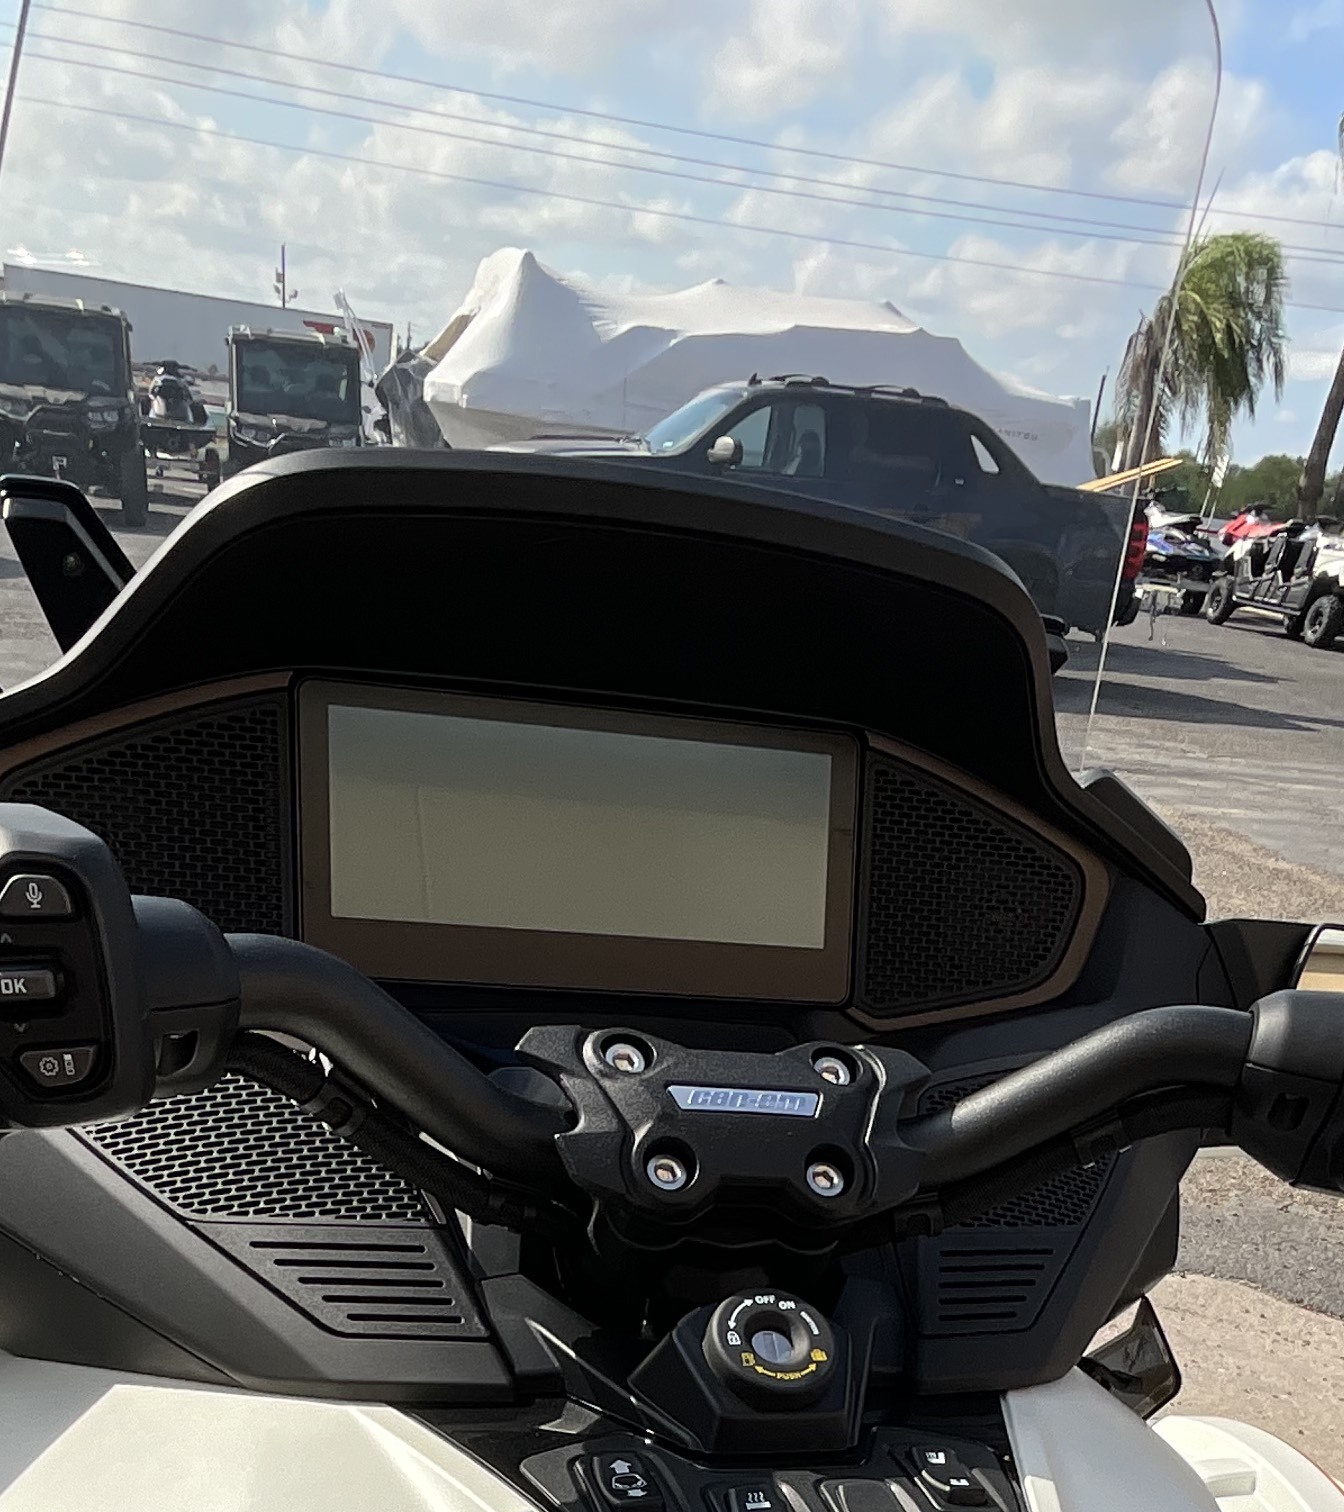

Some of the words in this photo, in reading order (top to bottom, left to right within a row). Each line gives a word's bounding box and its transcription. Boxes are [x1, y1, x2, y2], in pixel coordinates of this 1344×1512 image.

[1, 978, 27, 994] OK
[755, 1295, 775, 1304] OFF
[778, 1301, 796, 1309] ON
